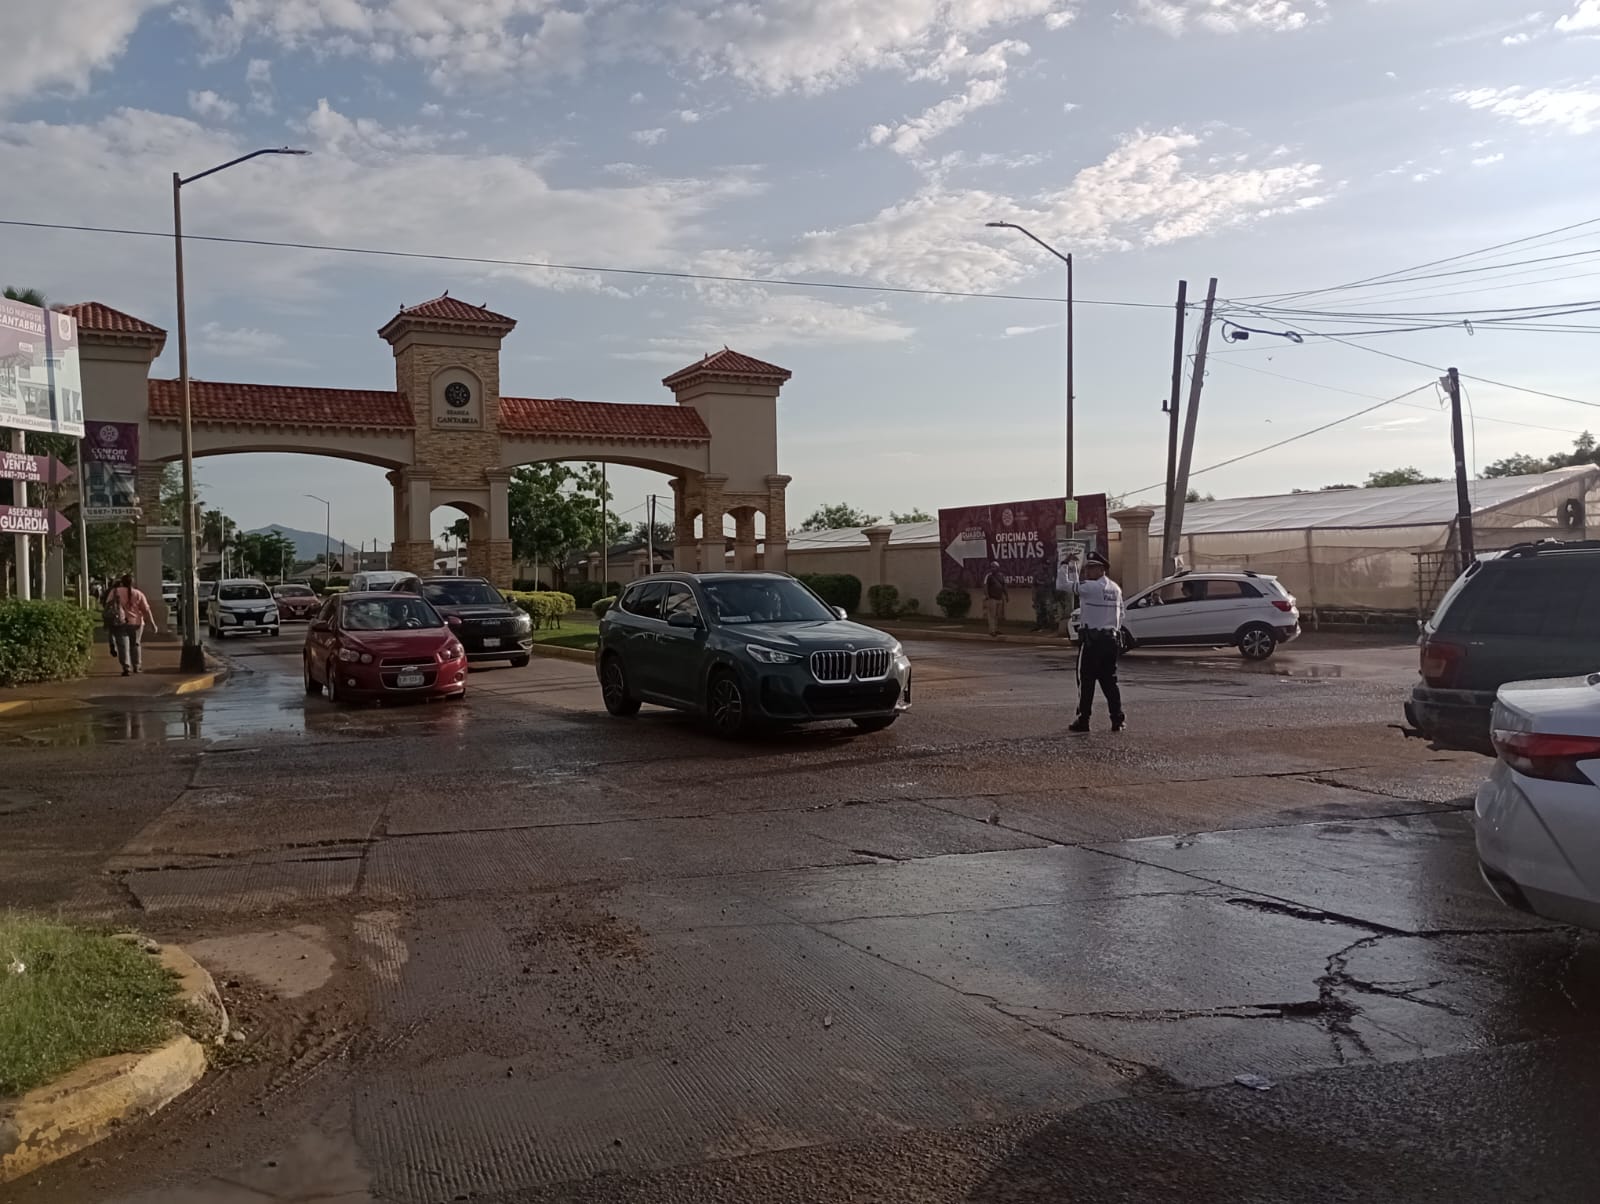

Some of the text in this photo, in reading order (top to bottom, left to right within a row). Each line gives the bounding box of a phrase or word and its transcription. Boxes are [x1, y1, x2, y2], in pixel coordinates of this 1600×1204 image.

[0, 313, 46, 333] ANTABRIA?
[91, 447, 128, 456] CONFORT
[2, 458, 38, 473] VENTAS
[8, 507, 42, 518] ASESOR EN
[0, 515, 49, 531] GUARDIA
[995, 531, 1039, 543] OFICINA DE
[991, 541, 1045, 560] VENTAS
